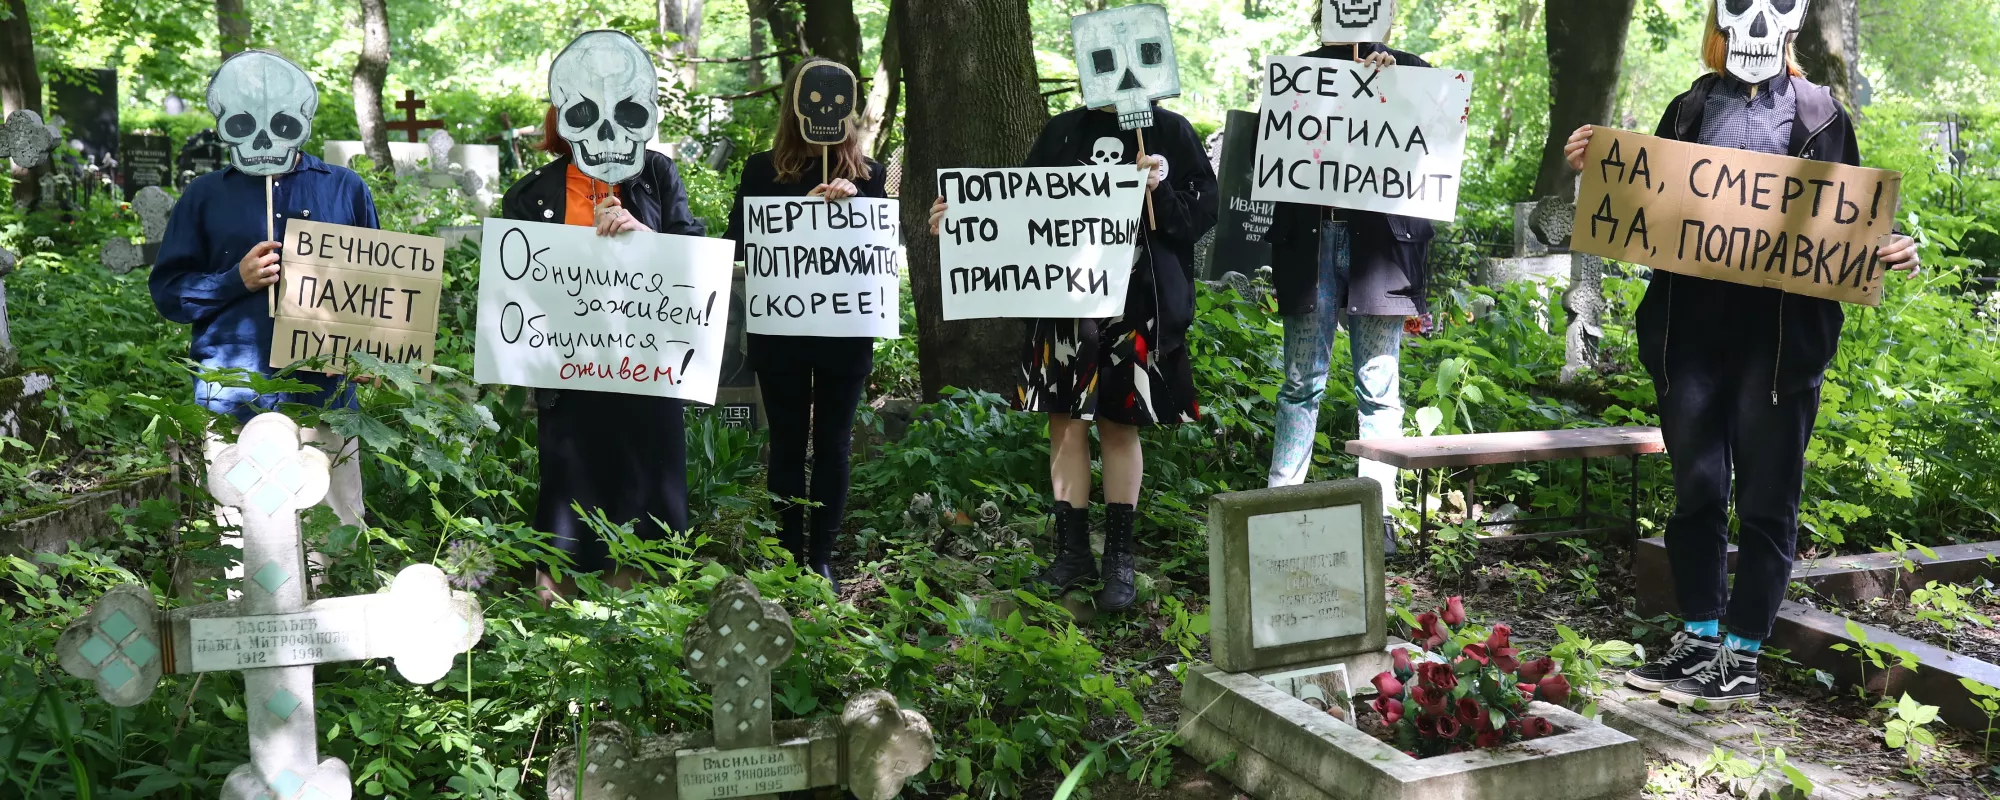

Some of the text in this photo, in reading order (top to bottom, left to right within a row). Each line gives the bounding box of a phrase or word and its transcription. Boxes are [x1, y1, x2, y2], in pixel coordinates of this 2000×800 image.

[1270, 63, 1379, 98] ВСЕХ
[1264, 109, 1429, 155] МОГИЛА
[1258, 154, 1453, 202] ИСПРАВИТ
[1600, 138, 1882, 226] ДА, СМЕРТЬ!
[749, 201, 896, 239] МЕРТВЫЕ,
[945, 216, 1140, 247] ЧТО МЕРТВЫМ
[1245, 233, 1261, 242] 1937
[296, 231, 435, 272] ВЕЧНОСТЬ
[1591, 193, 1881, 292] ДА, ПОПРАВКИ!
[950, 264, 1109, 296] ПРИПАРКИ
[298, 275, 421, 323] ПАХНЕТ
[574, 290, 717, 327] заживем!
[750, 286, 886, 319] СКОРЕЕ!
[291, 329, 422, 374] ПУТИНЫМ
[560, 348, 695, 386] оживем!
[236, 618, 318, 634] ВАСИЛЬЕВ
[250, 631, 353, 649] МИТРОФАНОВИ
[237, 648, 323, 665] 1912 1998
[703, 752, 785, 771] ВАСИЛЬЕВА
[712, 779, 783, 797] 1914 1995
